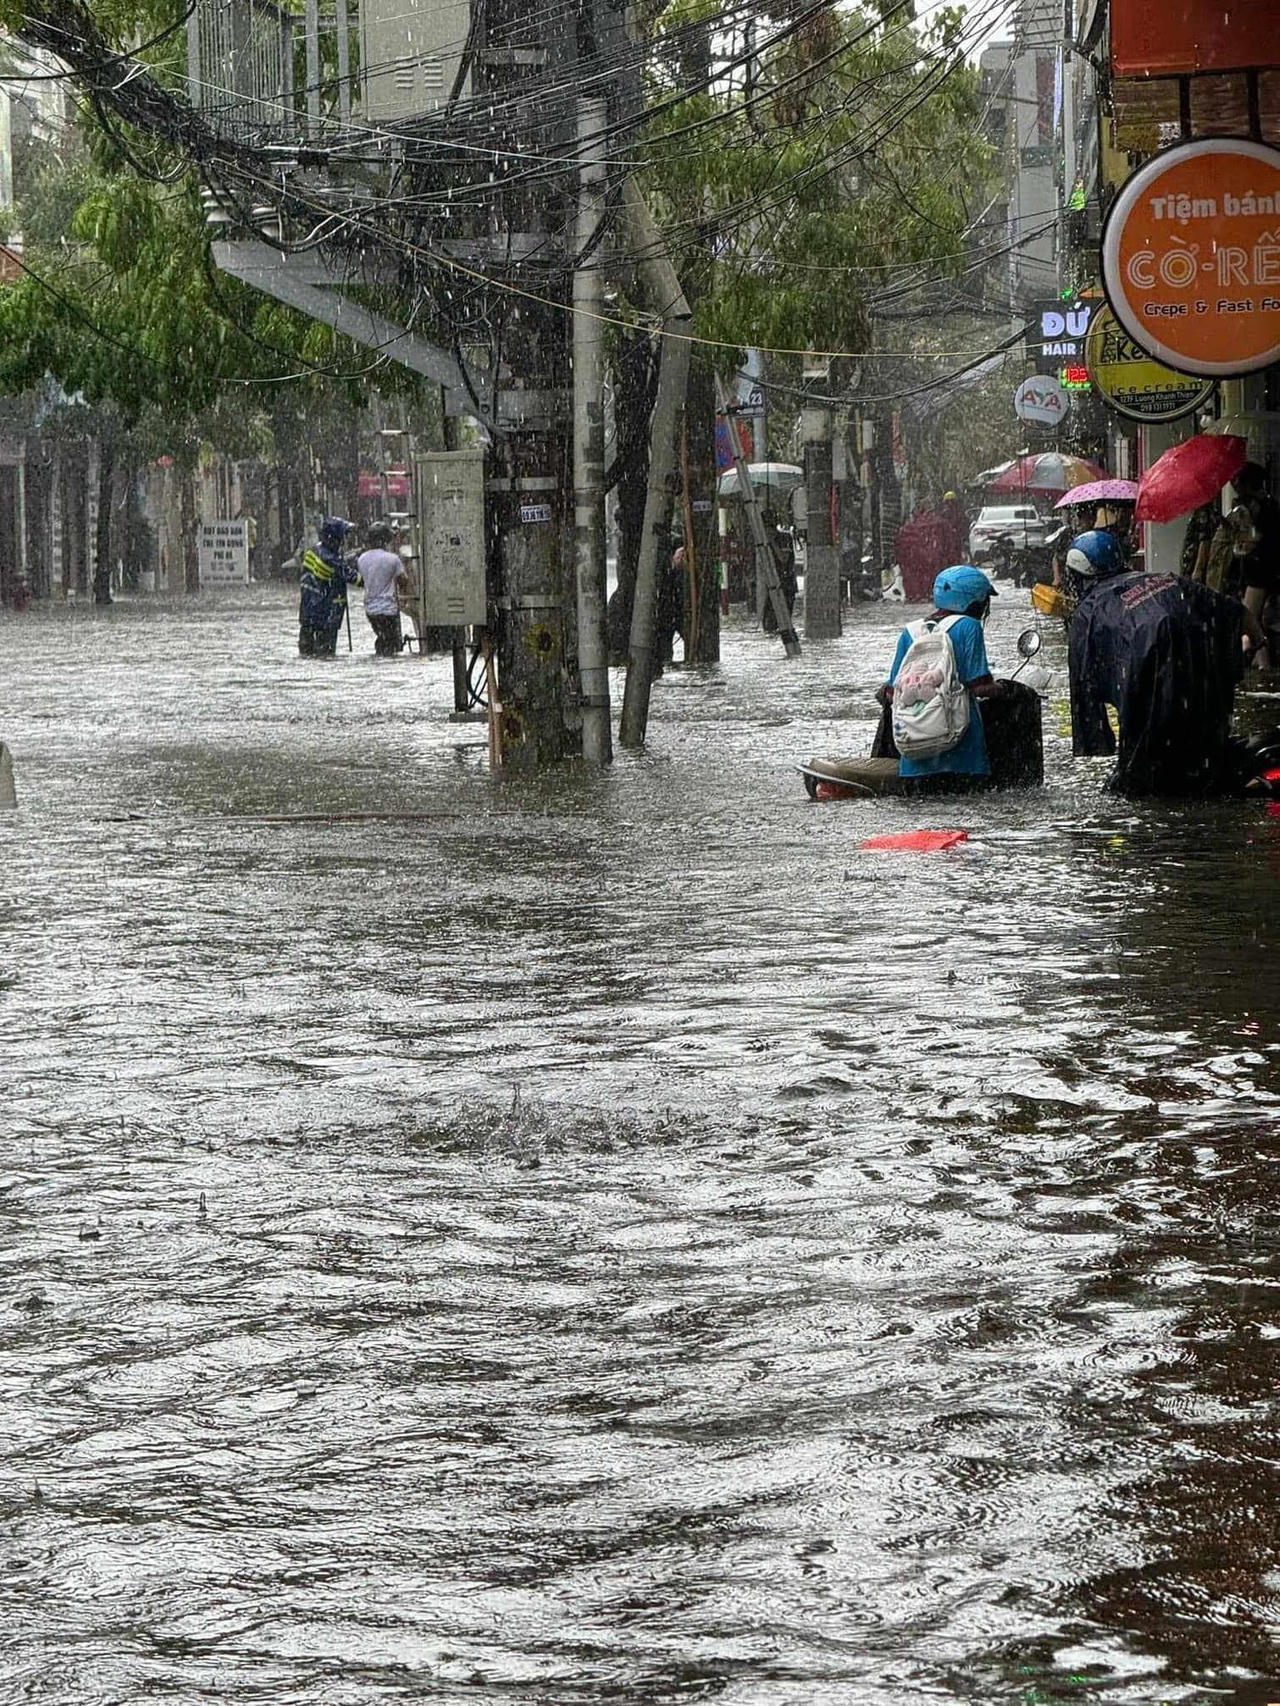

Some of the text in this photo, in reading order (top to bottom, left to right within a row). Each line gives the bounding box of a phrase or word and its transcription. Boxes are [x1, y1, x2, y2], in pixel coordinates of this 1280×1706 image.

[1150, 193, 1218, 225] Tiệm
[1144, 301, 1188, 317] Crepe
[1195, 300, 1208, 314] &
[1216, 299, 1254, 313] Fast
[1042, 343, 1077, 357] HAIR
[1143, 380, 1203, 394] cream
[1020, 389, 1062, 410] AYA
